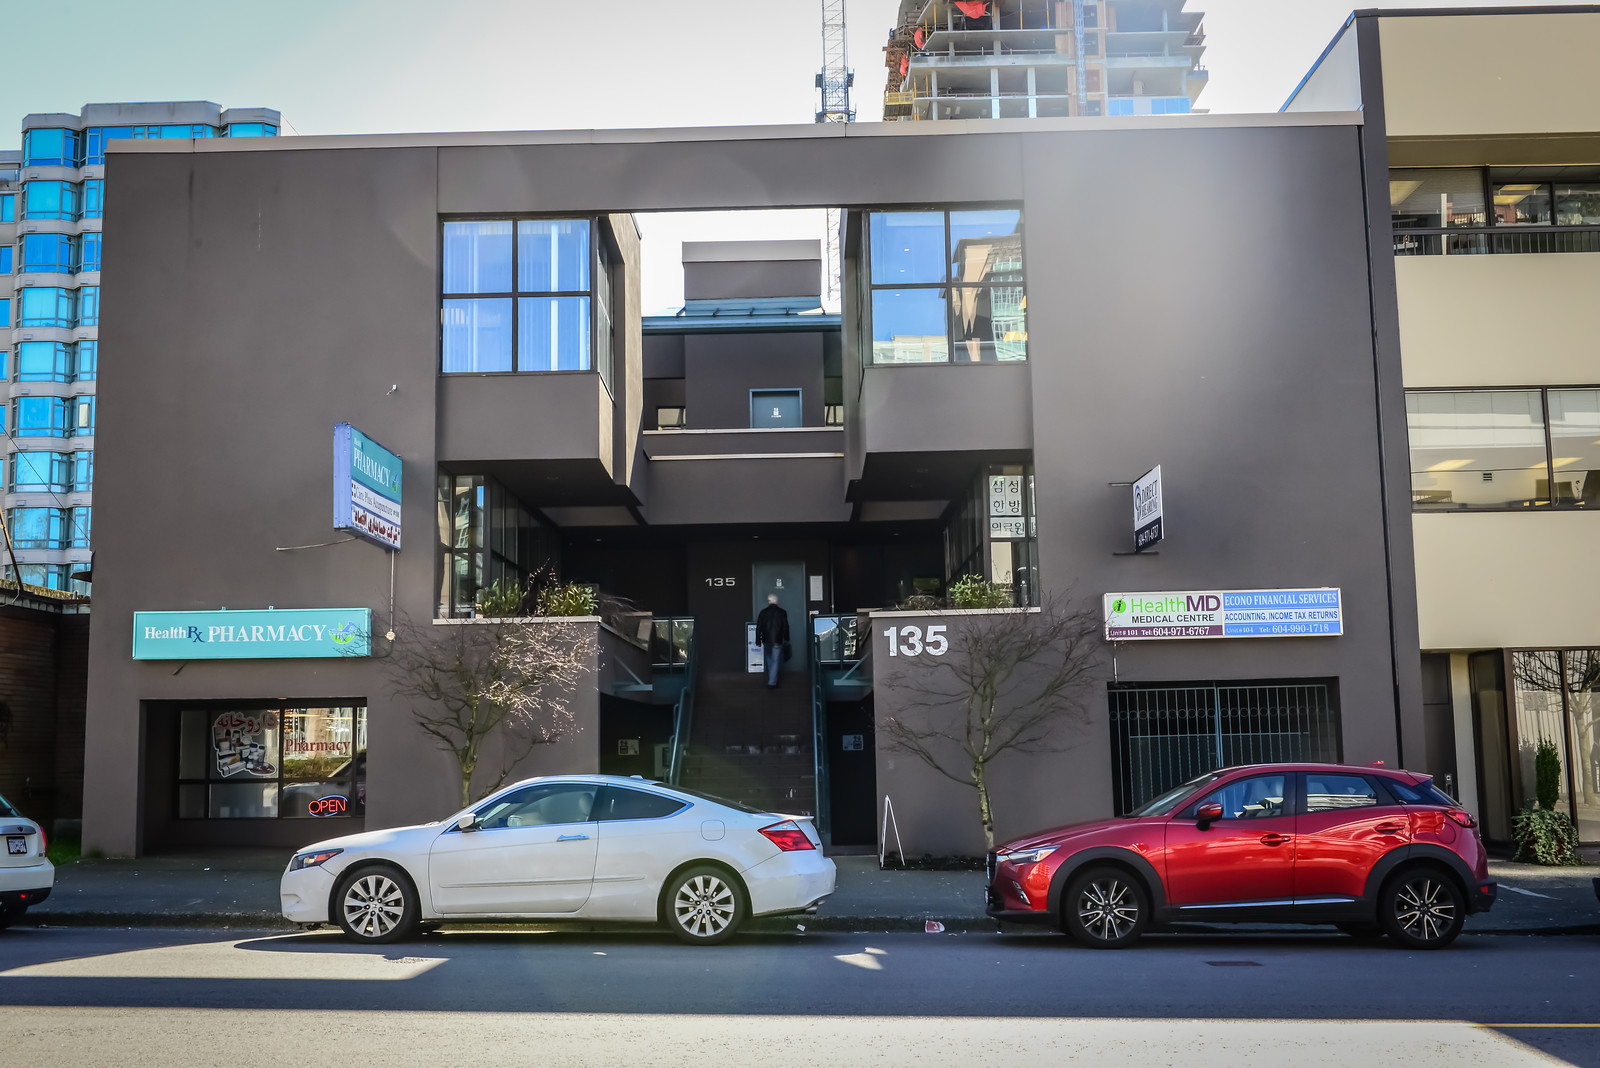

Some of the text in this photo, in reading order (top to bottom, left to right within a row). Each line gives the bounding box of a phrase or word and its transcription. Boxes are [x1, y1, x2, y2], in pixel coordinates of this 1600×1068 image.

[353, 448, 391, 487] PHARMACY
[992, 480, 1019, 494] 삼성
[993, 500, 1020, 513] 한방
[705, 577, 736, 587] 135
[1131, 595, 1221, 613] HealthMD
[1224, 593, 1337, 606] ECONO FINANCIAL SERVICES
[1131, 614, 1215, 624] MEDICAL CENTRE
[1224, 611, 1338, 621] ACCOUNTING, INCOME TAX RETURNS
[207, 625, 327, 643] PHARMACY
[1153, 627, 1210, 636] 604-971-6767
[1272, 624, 1329, 633] 604-990-1718
[884, 625, 949, 657] 135
[217, 713, 276, 733] داروخانه
[285, 739, 351, 752] Pharmacy
[308, 799, 346, 813] OPEN
